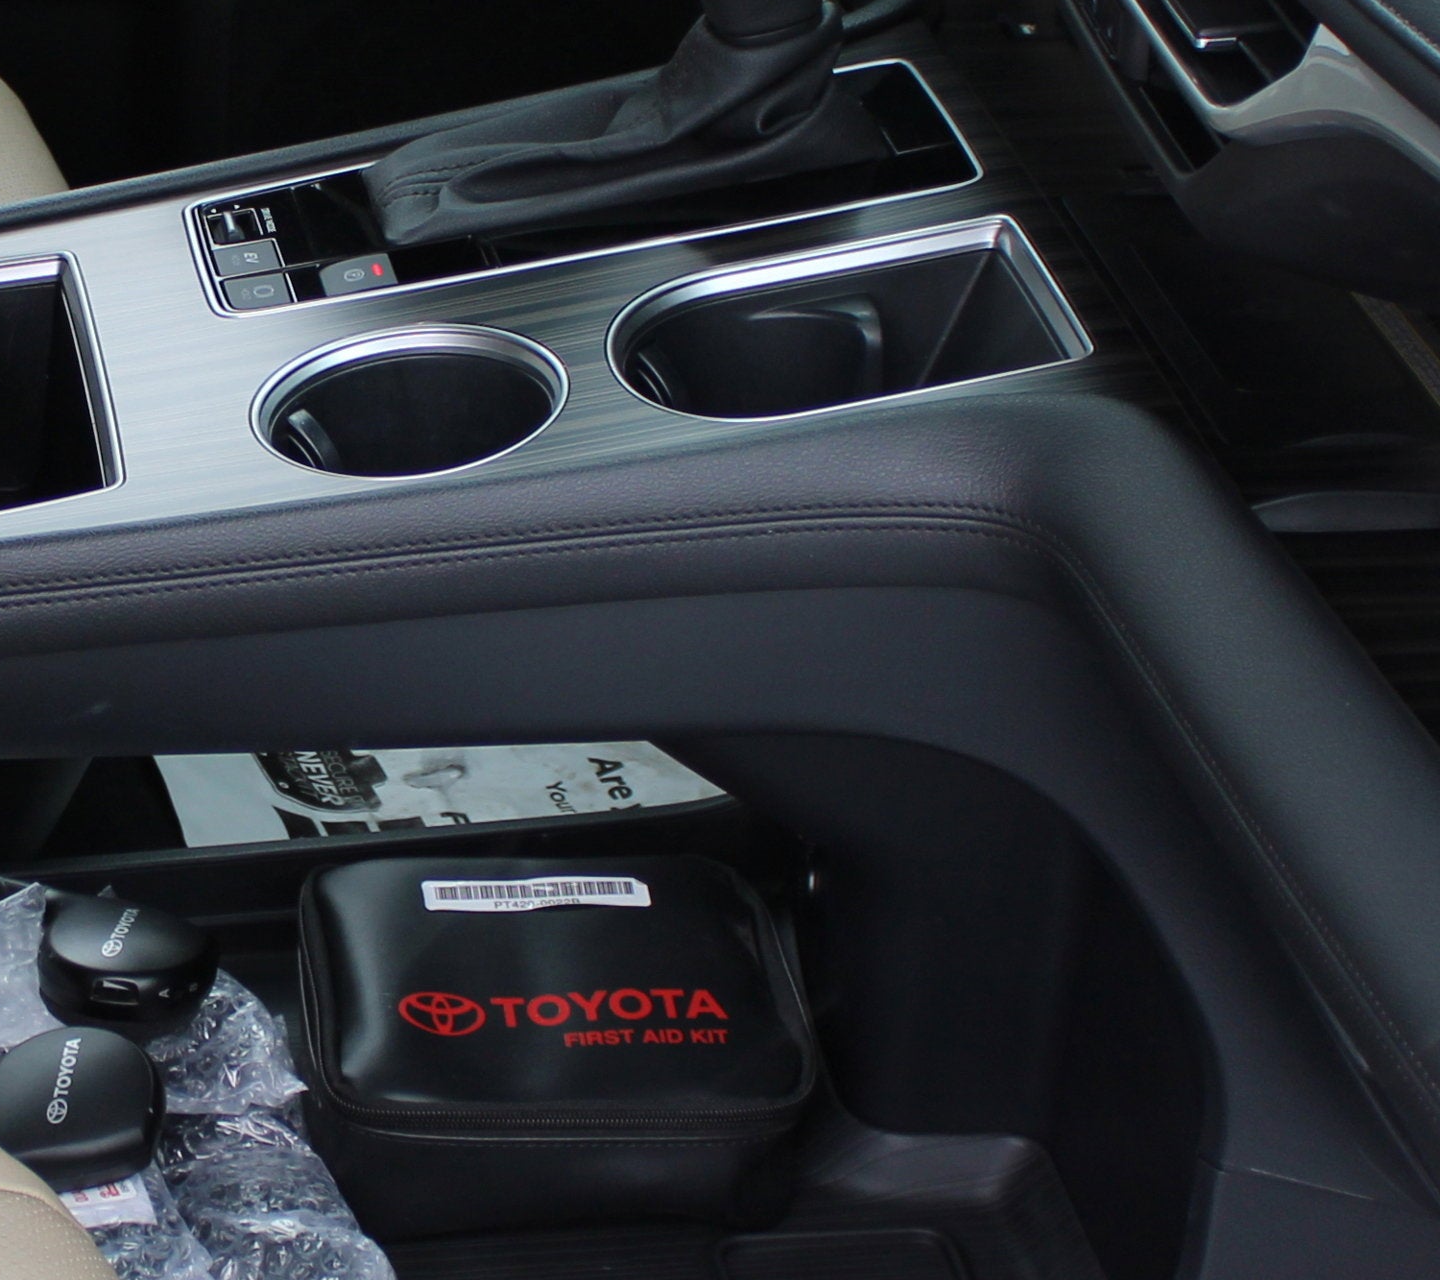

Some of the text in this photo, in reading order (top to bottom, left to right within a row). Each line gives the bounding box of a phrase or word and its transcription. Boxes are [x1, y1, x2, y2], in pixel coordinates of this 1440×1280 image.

[243, 252, 260, 264] EV
[294, 751, 345, 806] NEVER
[587, 757, 633, 800] Are
[110, 908, 141, 939] TOYOTA
[490, 987, 729, 1028] TOYOTA
[564, 1028, 728, 1047] FIRST AID KIT
[54, 1037, 83, 1098] TOYOTA
